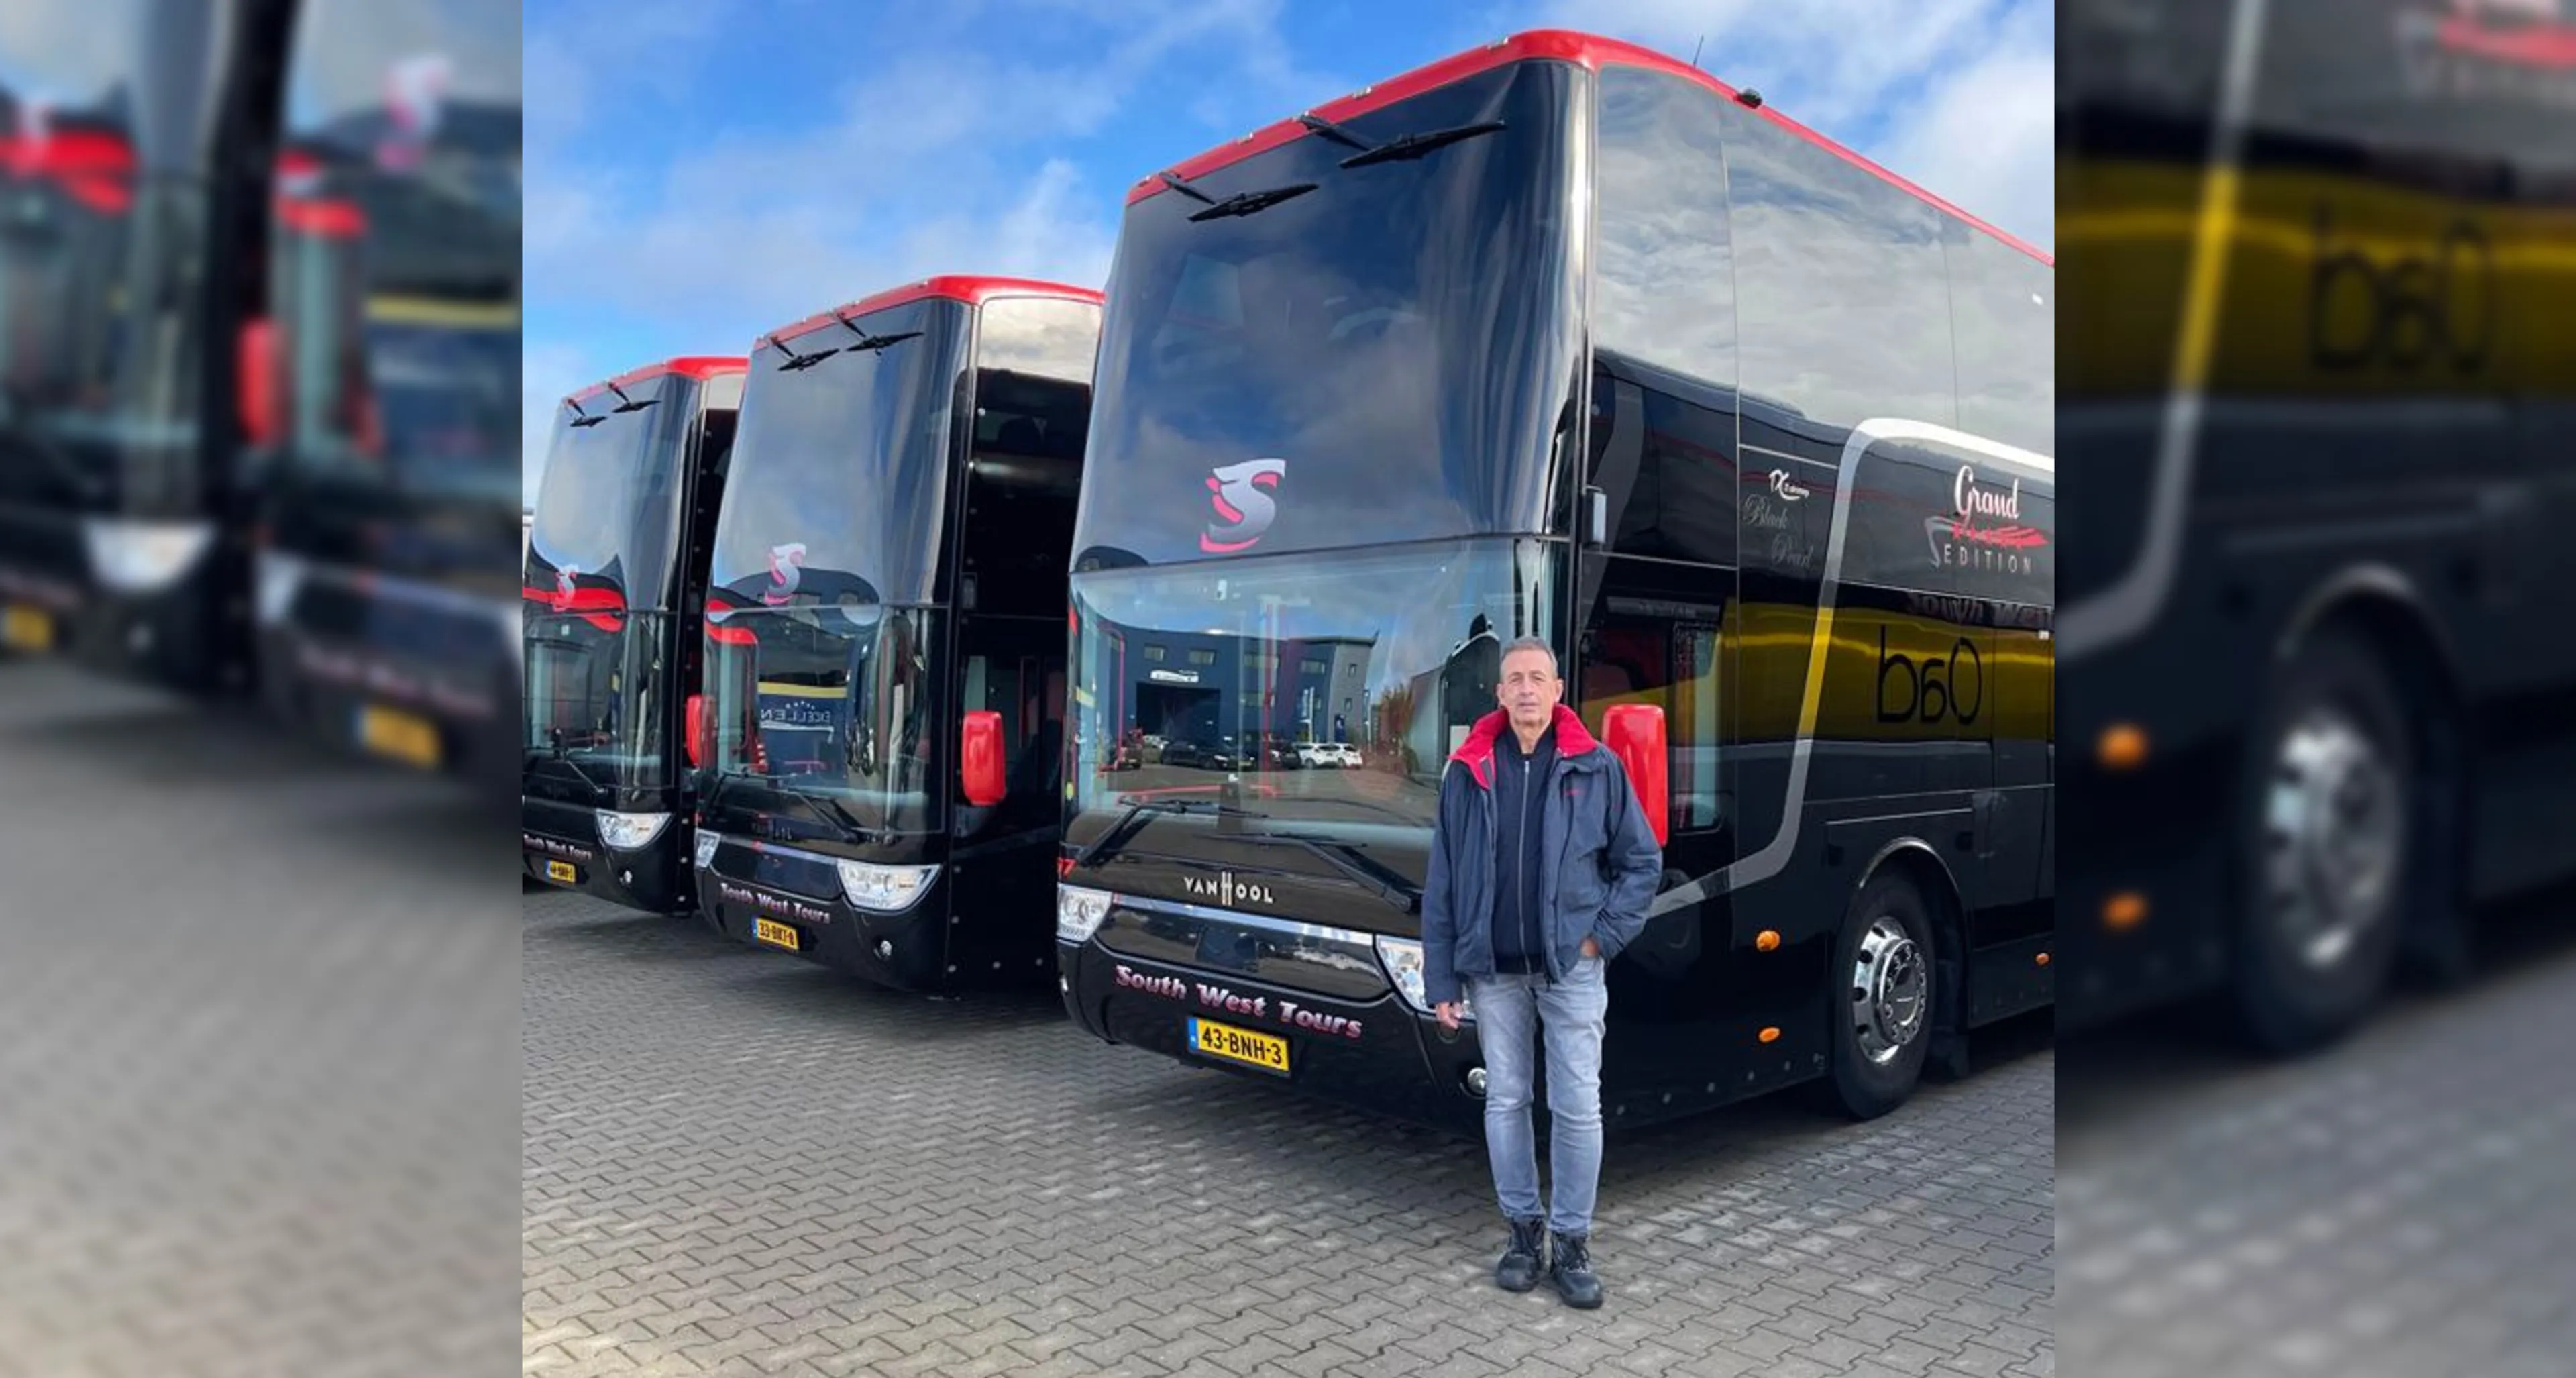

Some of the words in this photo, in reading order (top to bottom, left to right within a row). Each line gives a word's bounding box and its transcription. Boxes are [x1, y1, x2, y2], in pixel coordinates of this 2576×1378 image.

[1955, 465, 2021, 529] Grand
[1943, 543, 2031, 576] EDITION
[756, 892, 789, 916] West
[792, 902, 832, 924] Tours
[1115, 964, 1187, 1000] South
[1196, 983, 1267, 1017] West
[1278, 1000, 1363, 1039] Tours
[1201, 1026, 1282, 1065] 43-BNH-3
